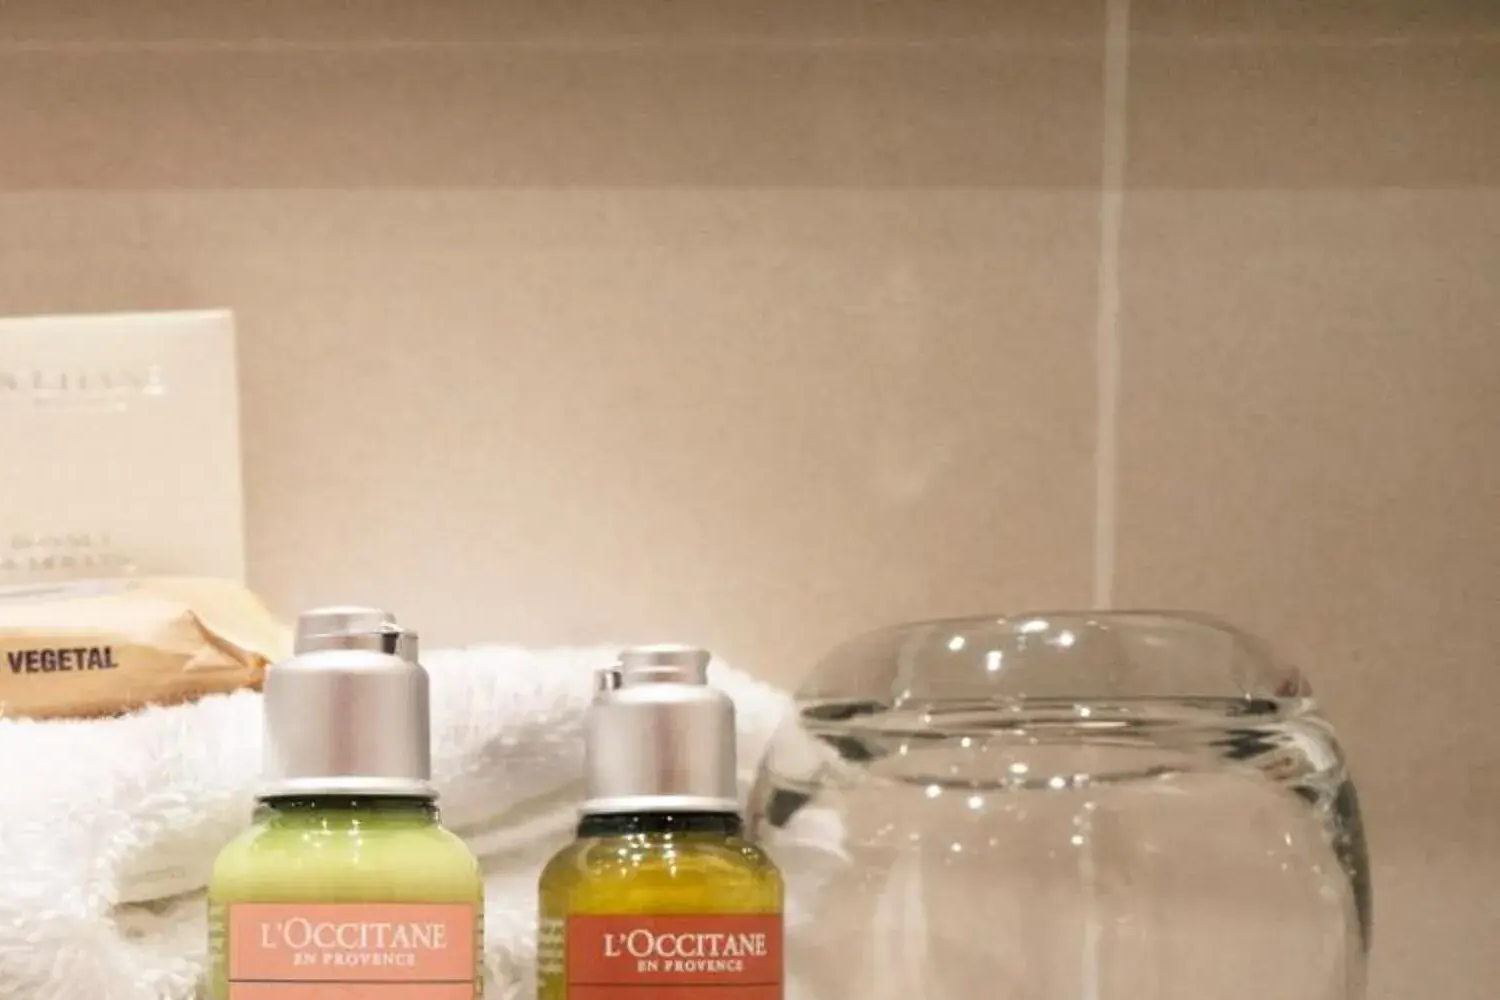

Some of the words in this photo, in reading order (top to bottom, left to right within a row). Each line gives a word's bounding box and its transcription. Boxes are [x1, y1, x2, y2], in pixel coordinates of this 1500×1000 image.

[8, 646, 119, 673] VEGETAL
[261, 917, 447, 948] L'OCCITANE
[604, 929, 767, 957] L'OCCITANE
[294, 953, 316, 966] EN
[323, 953, 416, 966] PROVENCE
[638, 960, 659, 973] EN
[665, 960, 743, 973] PROVENCE
